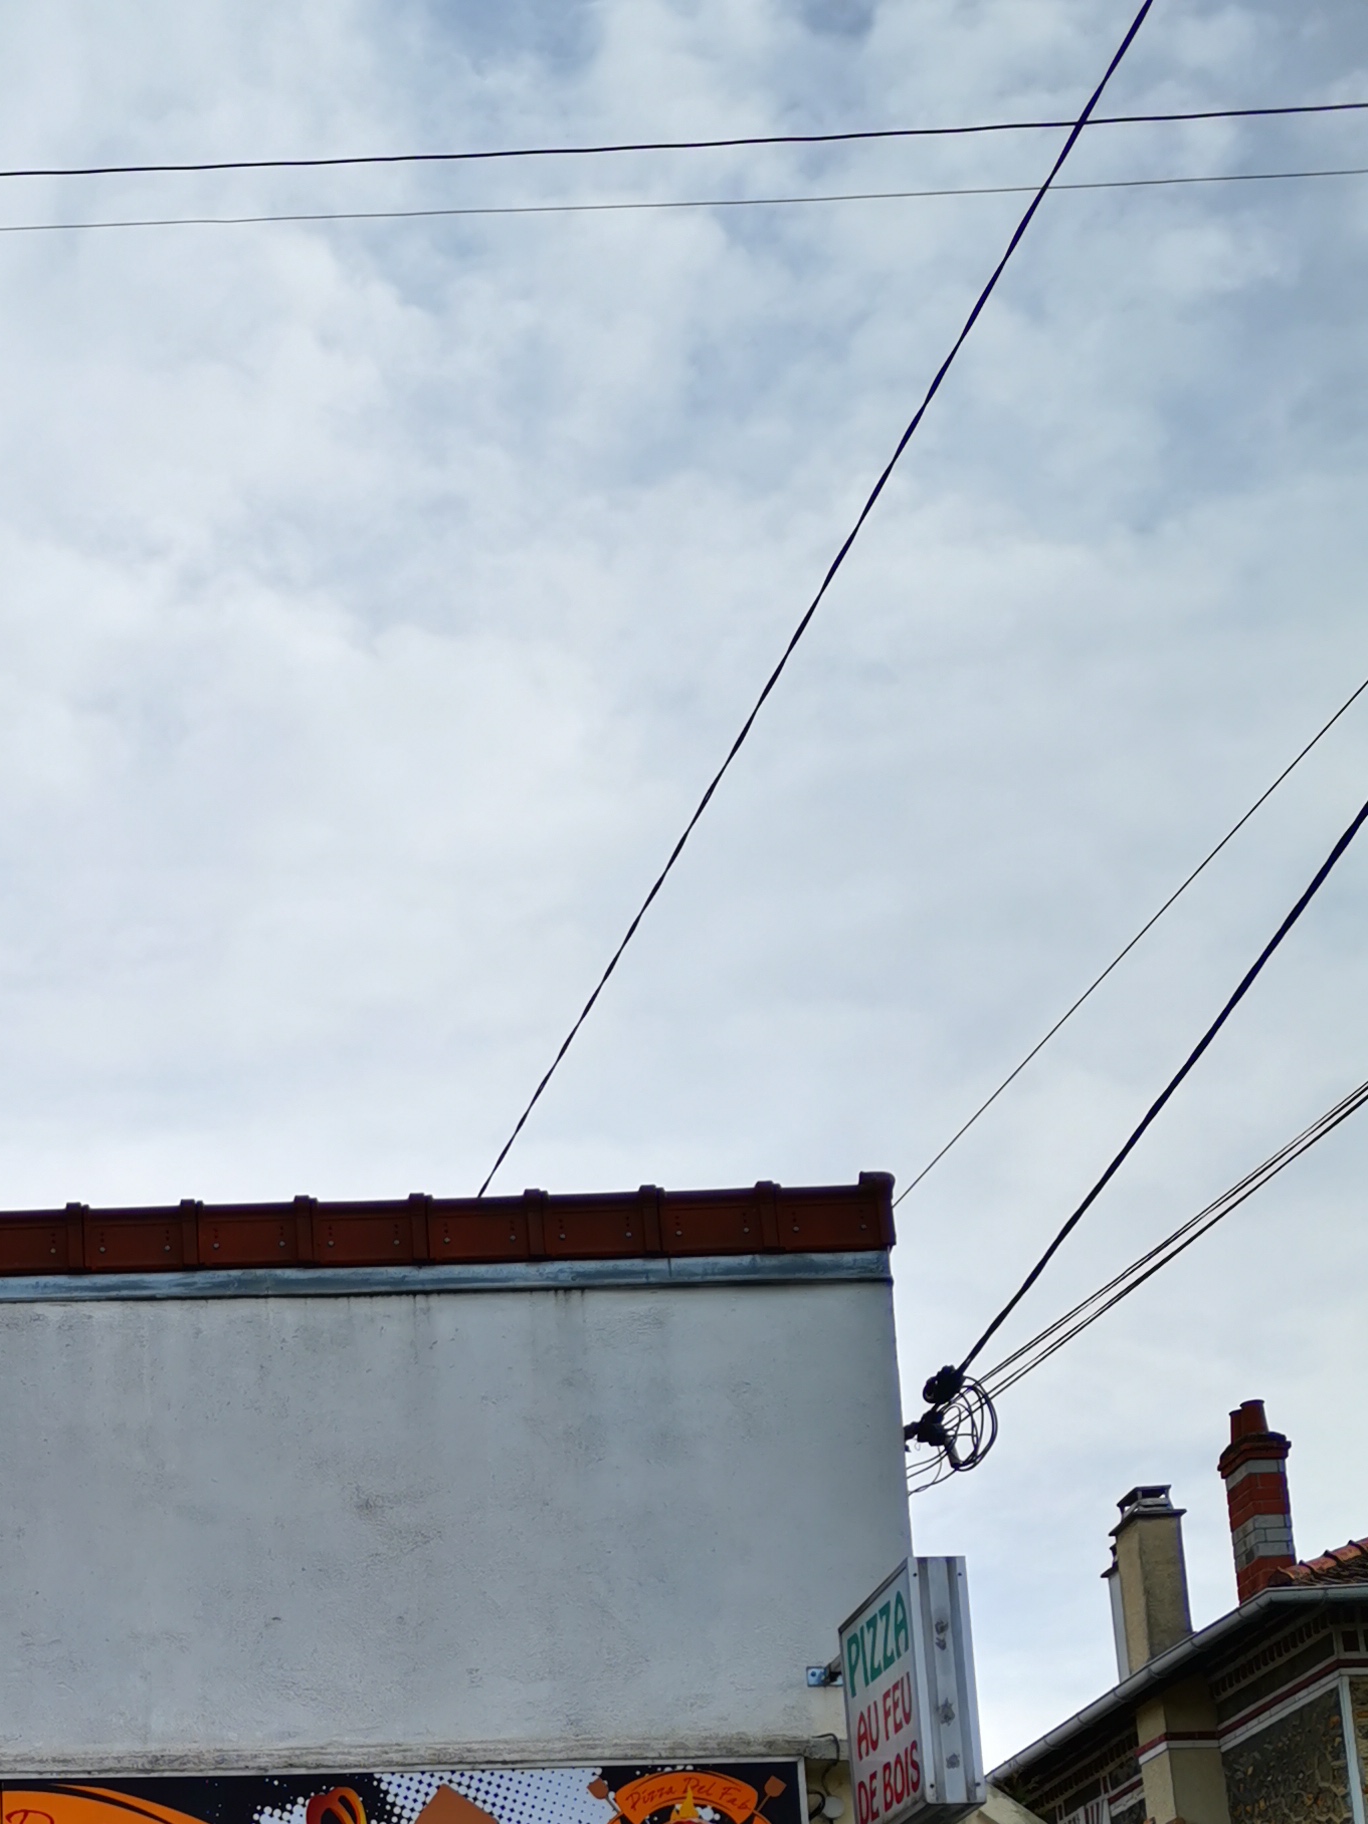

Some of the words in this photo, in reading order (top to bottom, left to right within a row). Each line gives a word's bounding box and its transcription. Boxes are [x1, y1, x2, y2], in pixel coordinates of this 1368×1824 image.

[846, 1589, 910, 1699] PIZZA
[856, 1699, 879, 1762] AU
[882, 1671, 913, 1743] FEU
[625, 1783, 678, 1811] Pizza
[682, 1776, 716, 1796] Del
[720, 1786, 752, 1811] Fab
[882, 1739, 921, 1814] BOIS
